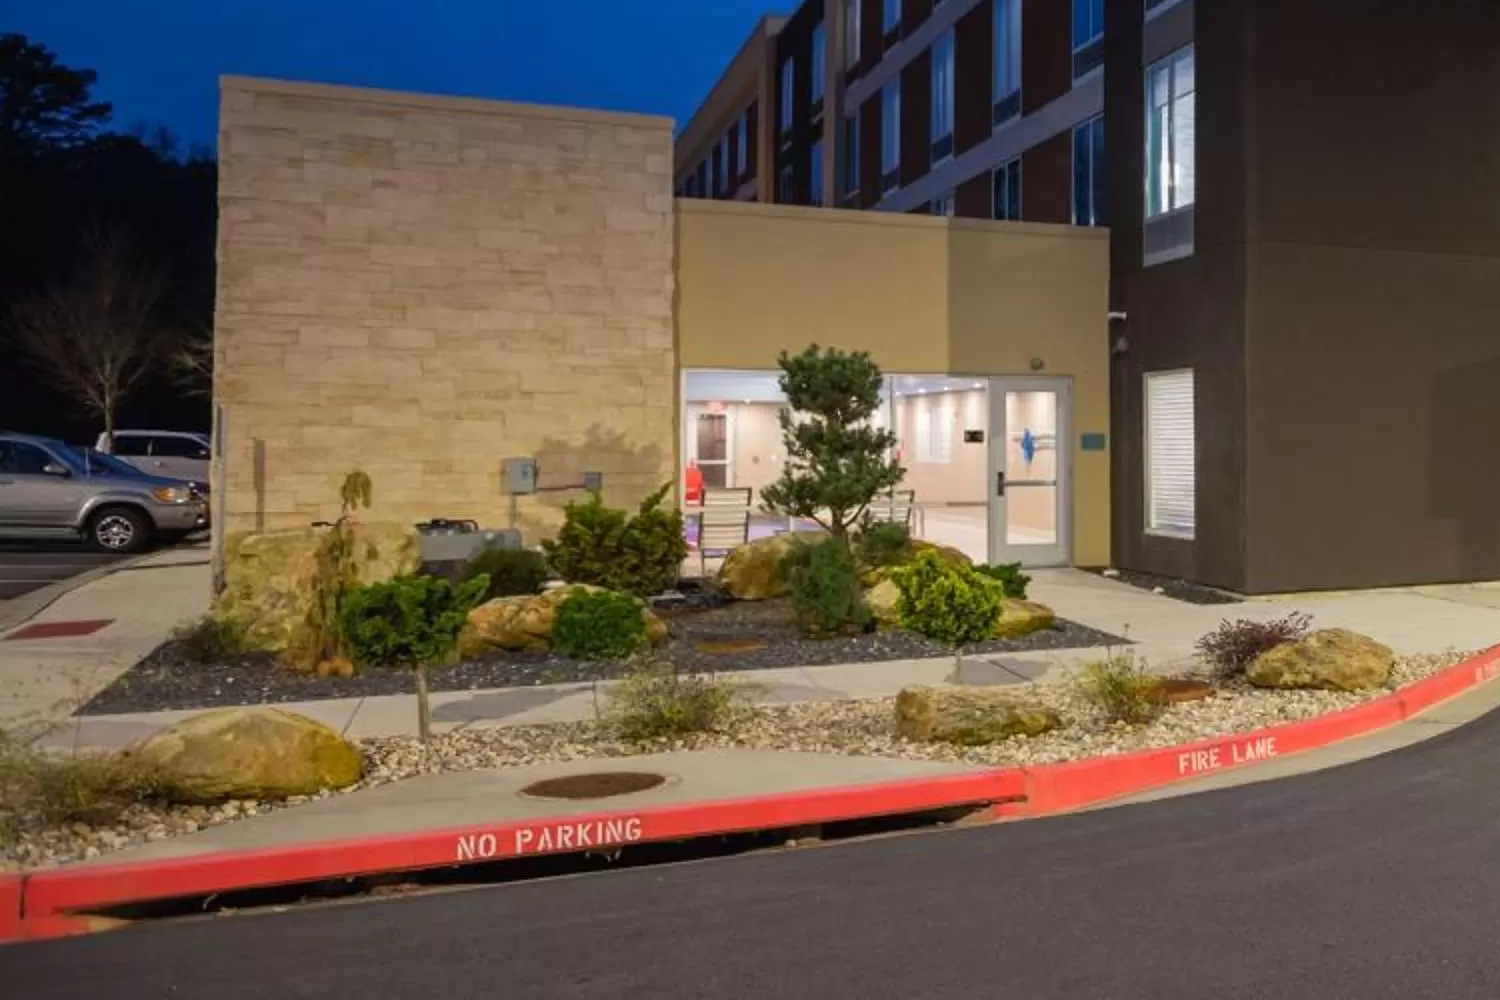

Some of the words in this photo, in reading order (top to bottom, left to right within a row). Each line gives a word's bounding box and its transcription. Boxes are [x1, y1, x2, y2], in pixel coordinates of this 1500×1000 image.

[1179, 747, 1222, 775] FIRE
[1232, 737, 1277, 763] LANE
[457, 833, 497, 861] NO
[515, 817, 642, 855] PARKING
